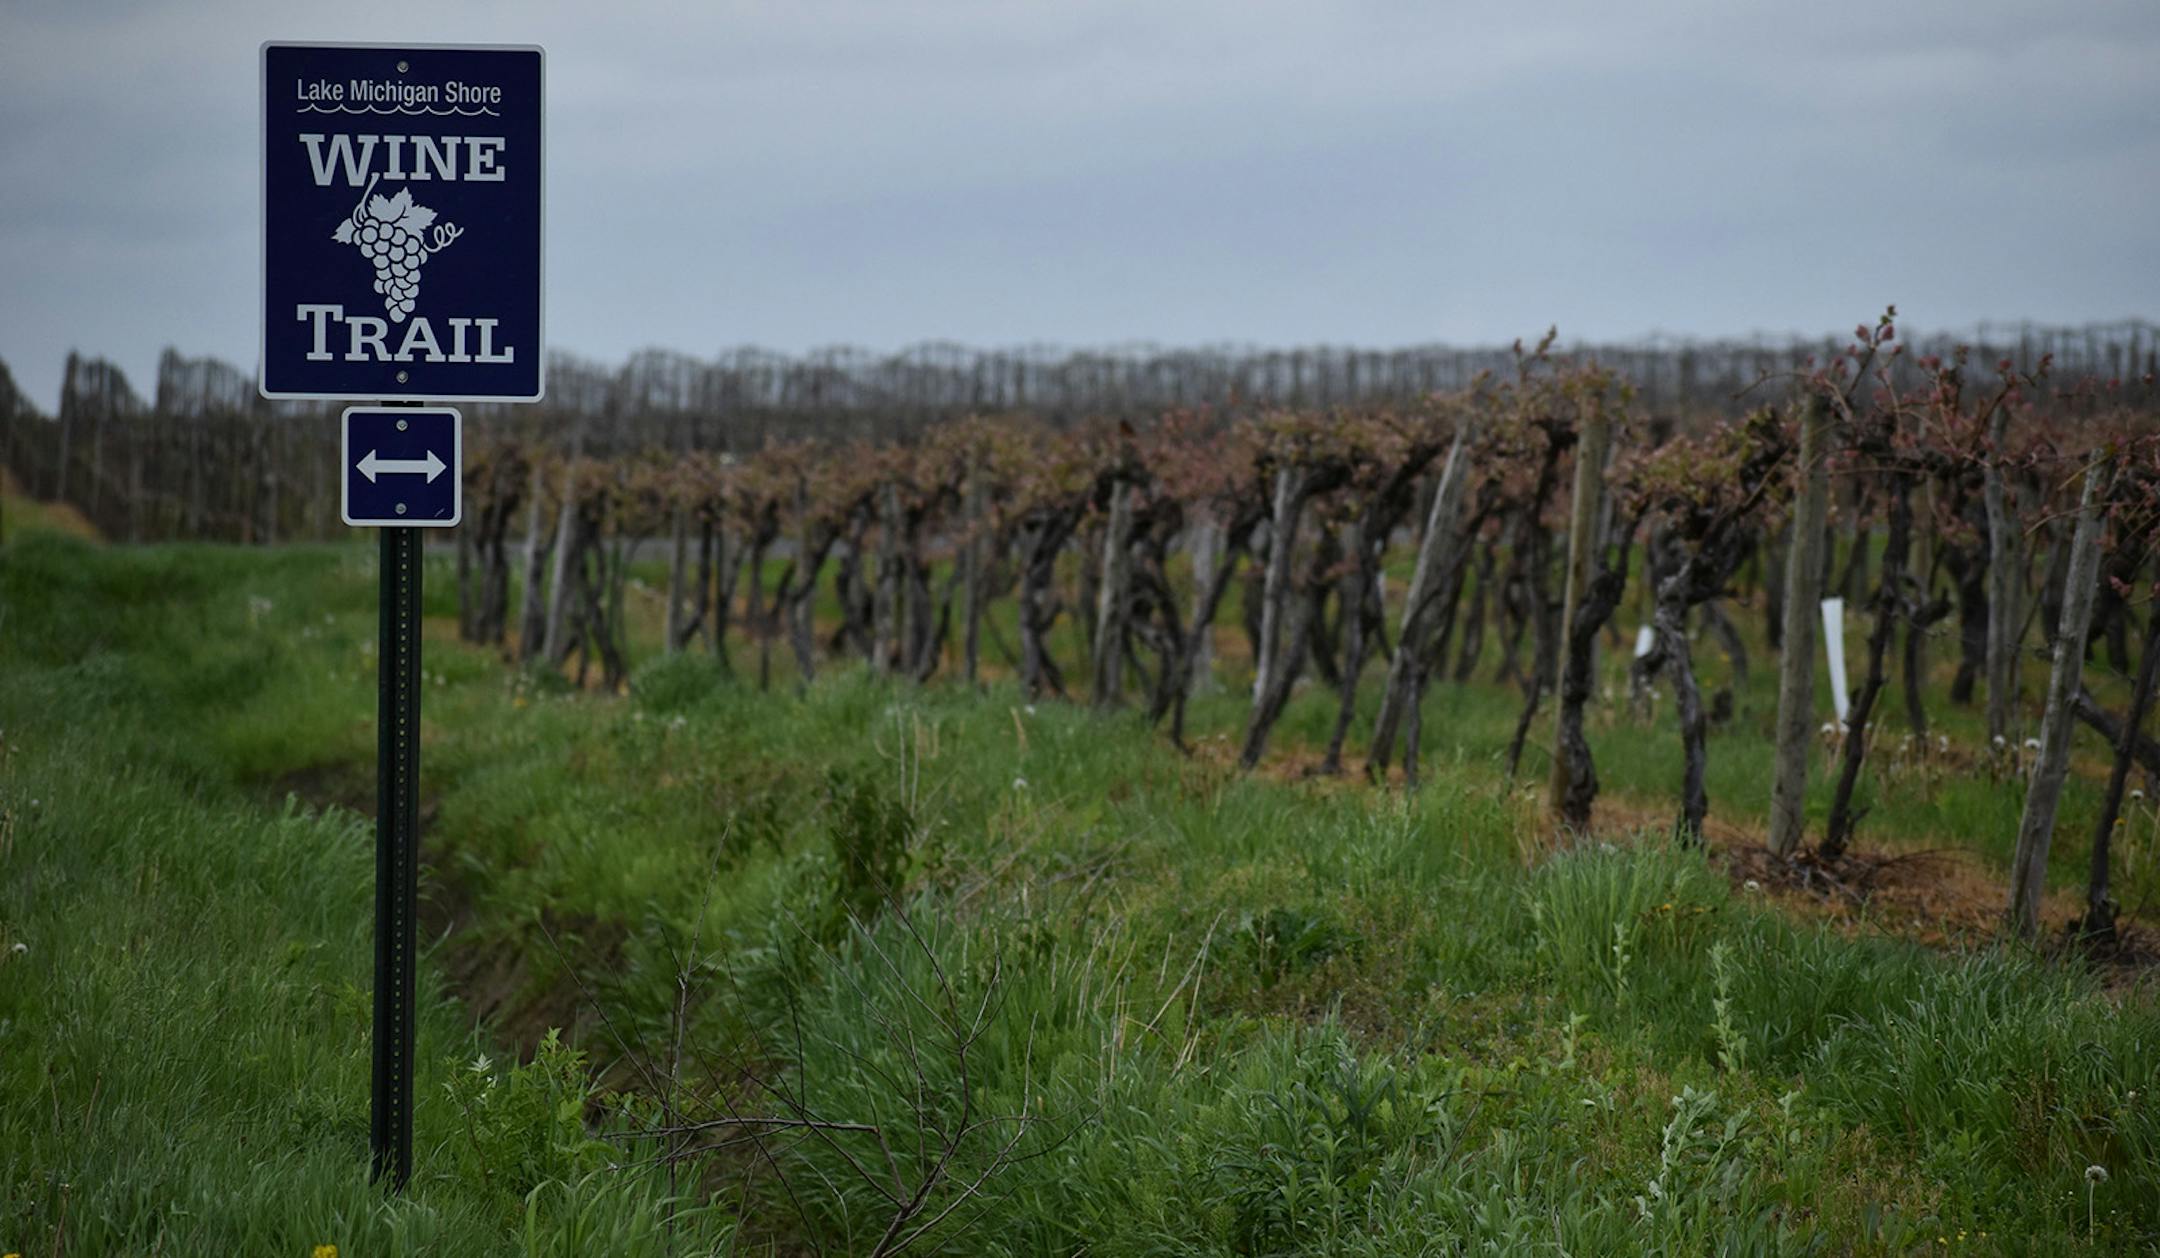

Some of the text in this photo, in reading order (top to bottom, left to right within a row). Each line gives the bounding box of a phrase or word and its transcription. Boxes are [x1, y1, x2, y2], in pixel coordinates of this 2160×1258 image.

[297, 78, 501, 107] Lake Michigan Shore
[299, 133, 506, 187] WINE
[297, 304, 514, 364] TRAIL
